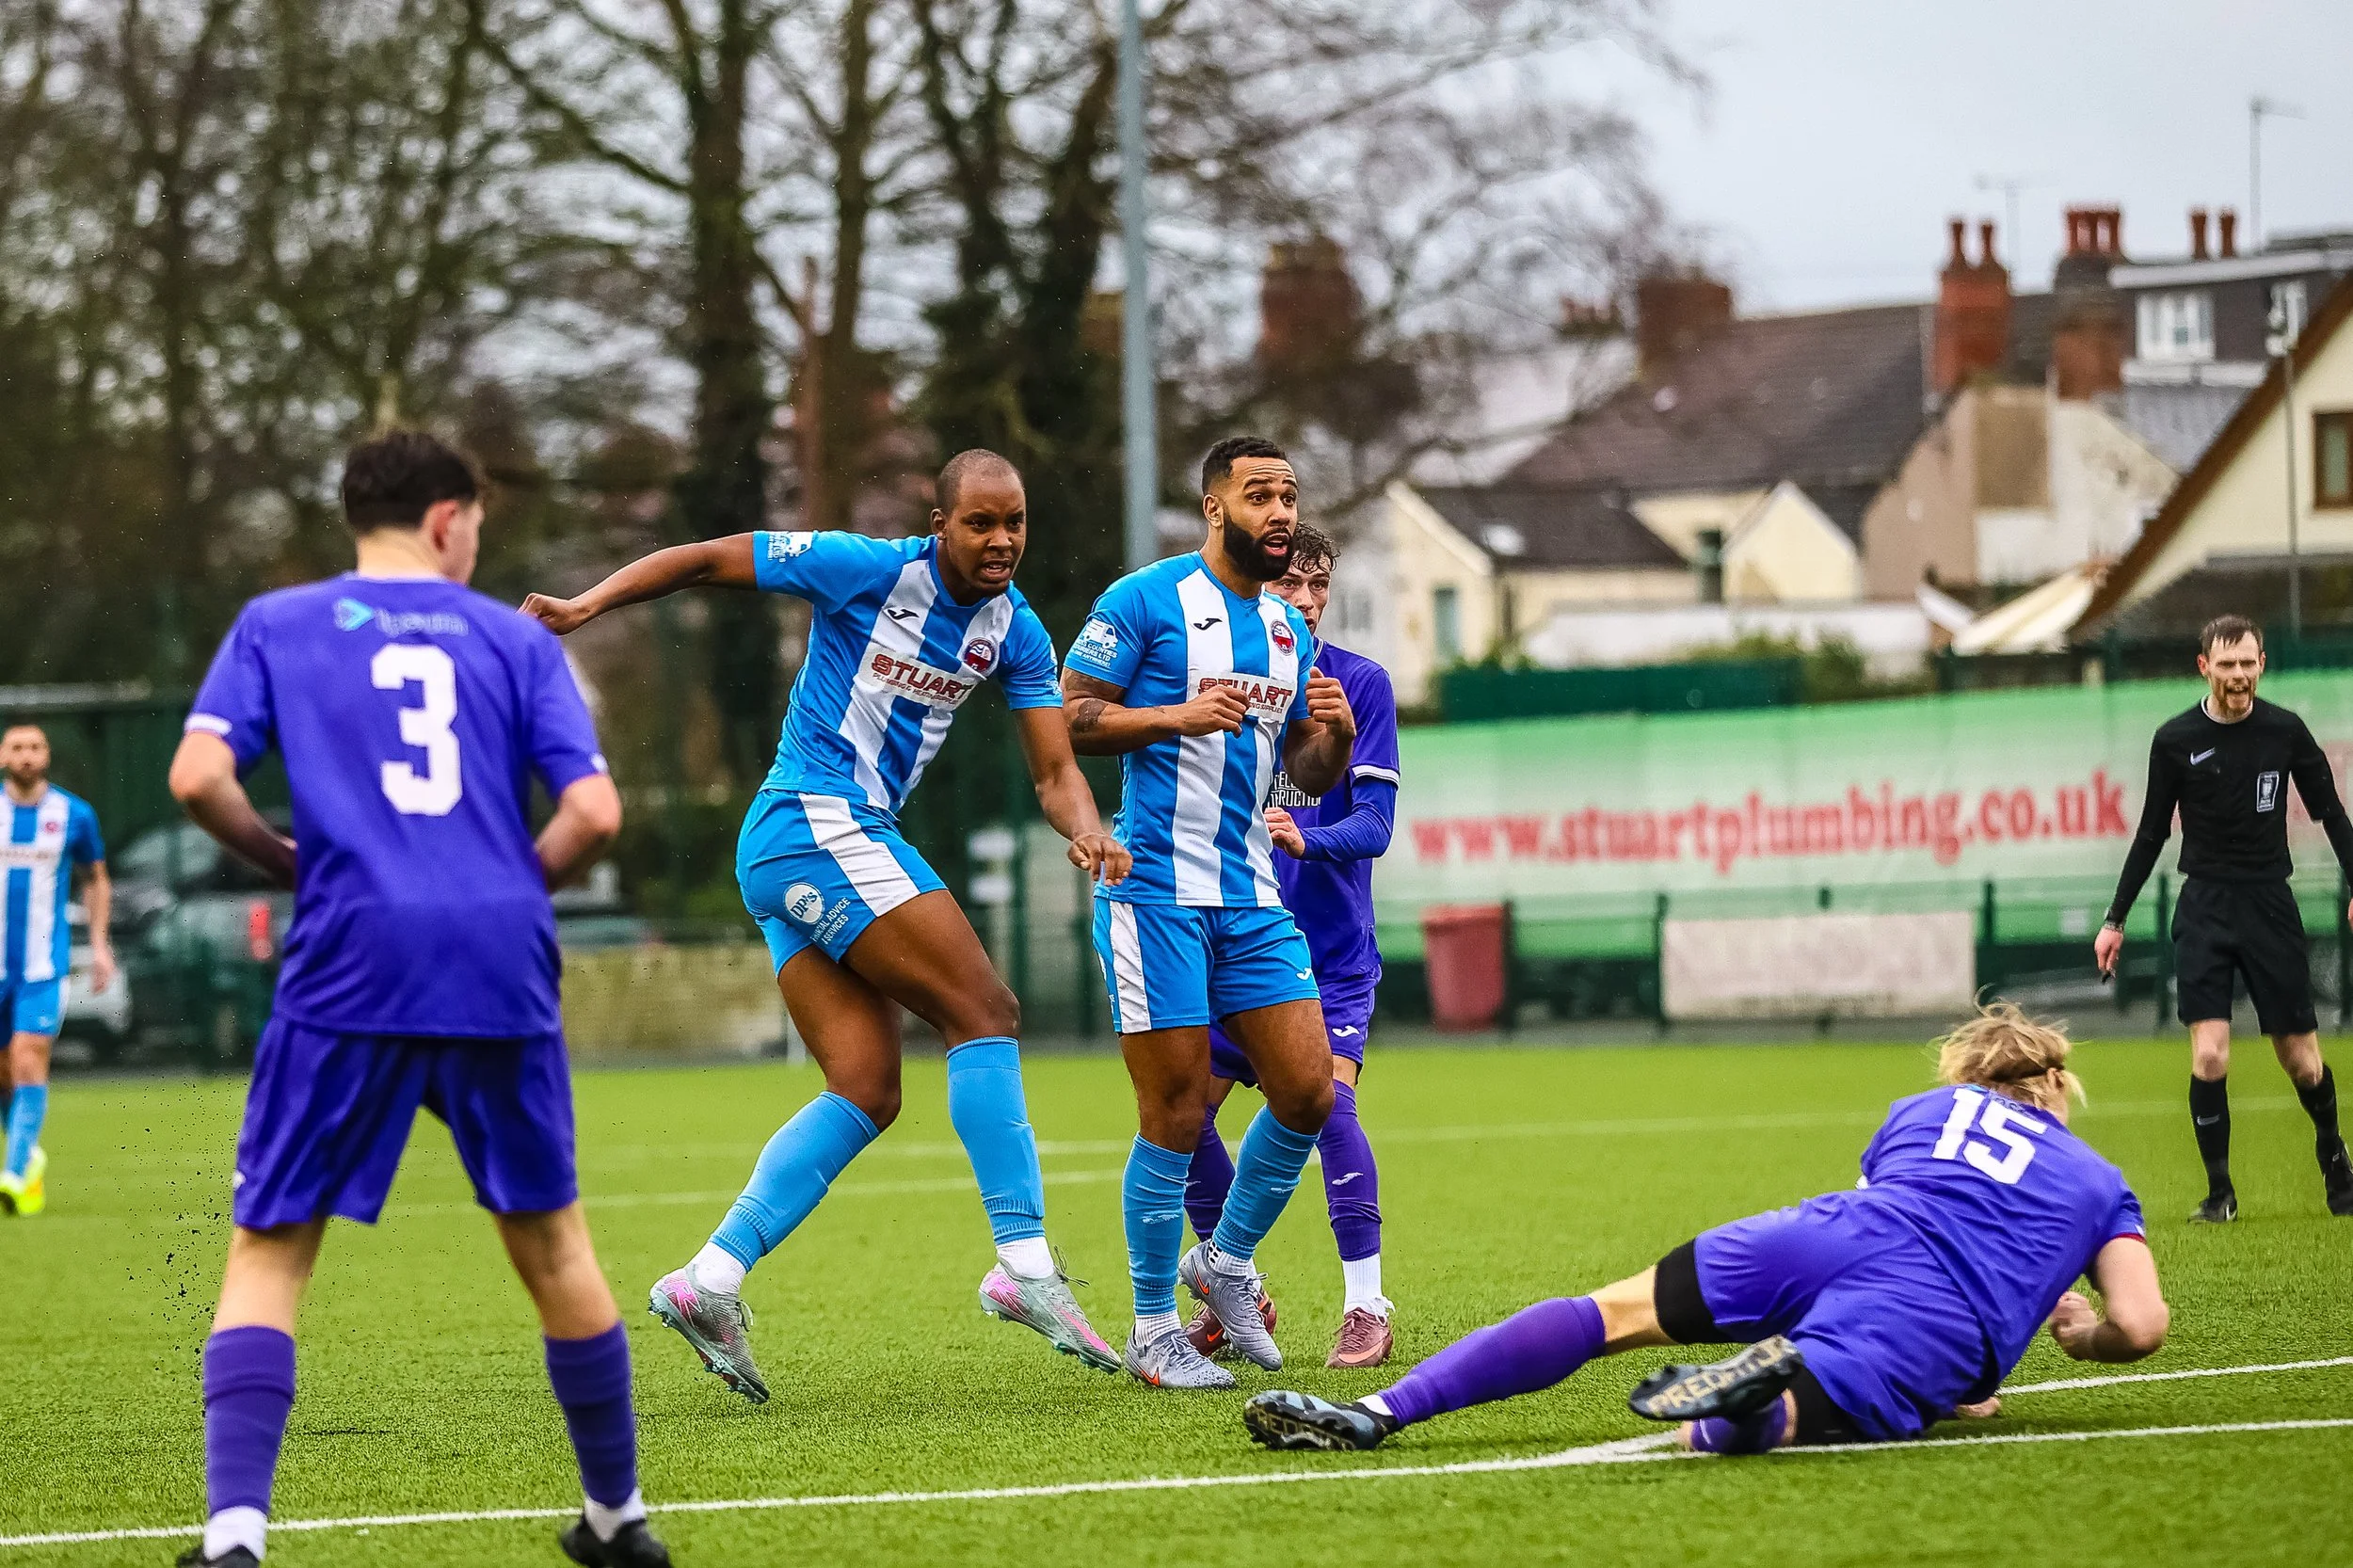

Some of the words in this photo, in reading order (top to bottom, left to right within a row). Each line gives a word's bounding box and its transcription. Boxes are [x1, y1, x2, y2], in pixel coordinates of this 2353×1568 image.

[1087, 643, 1118, 659] COUNTIES
[1097, 653, 1111, 662] LTD
[872, 653, 975, 699] STUART
[370, 646, 463, 817] 3
[1412, 767, 2129, 874] www.stuartplumbing.co.uk
[824, 913, 849, 941] SERVICES
[825, 897, 851, 922] ADVICE
[1930, 1087, 2048, 1185] 15
